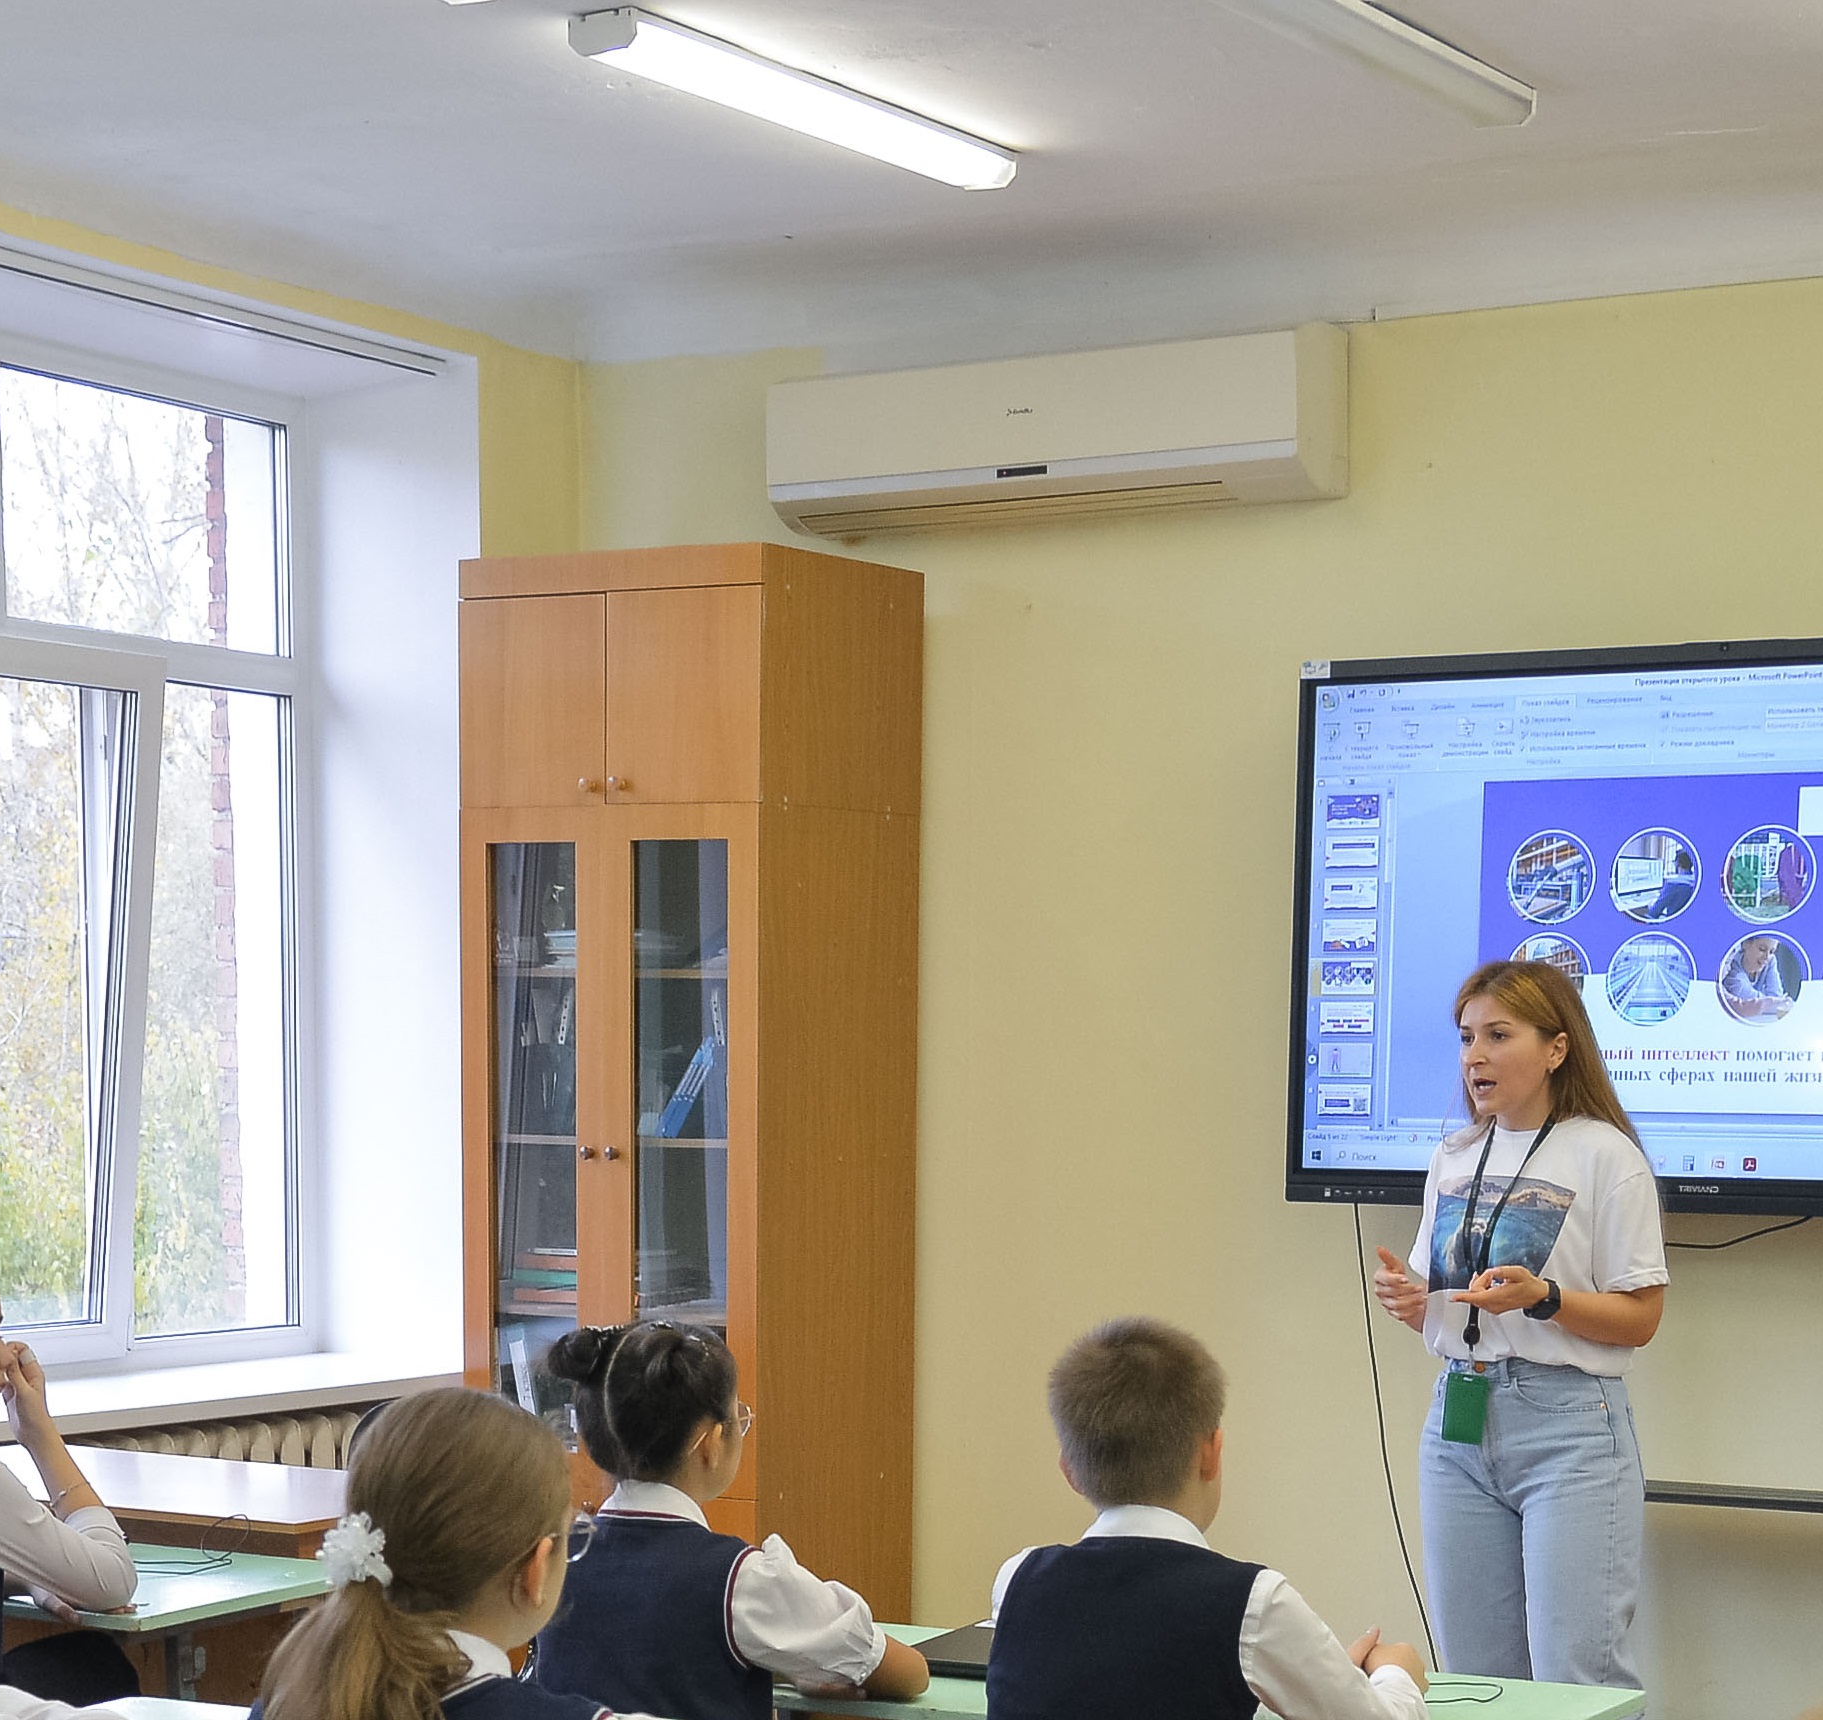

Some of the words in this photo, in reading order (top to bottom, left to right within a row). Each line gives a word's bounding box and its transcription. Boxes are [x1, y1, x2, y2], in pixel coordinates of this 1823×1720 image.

[1748, 672, 1781, 681] Microsoft
[1783, 671, 1823, 680] PowerPoint
[1642, 1049, 1730, 1061] интеллект
[1736, 1050, 1814, 1062] помогает
[1659, 1067, 1715, 1085] сферах
[1724, 1068, 1777, 1083] нашей
